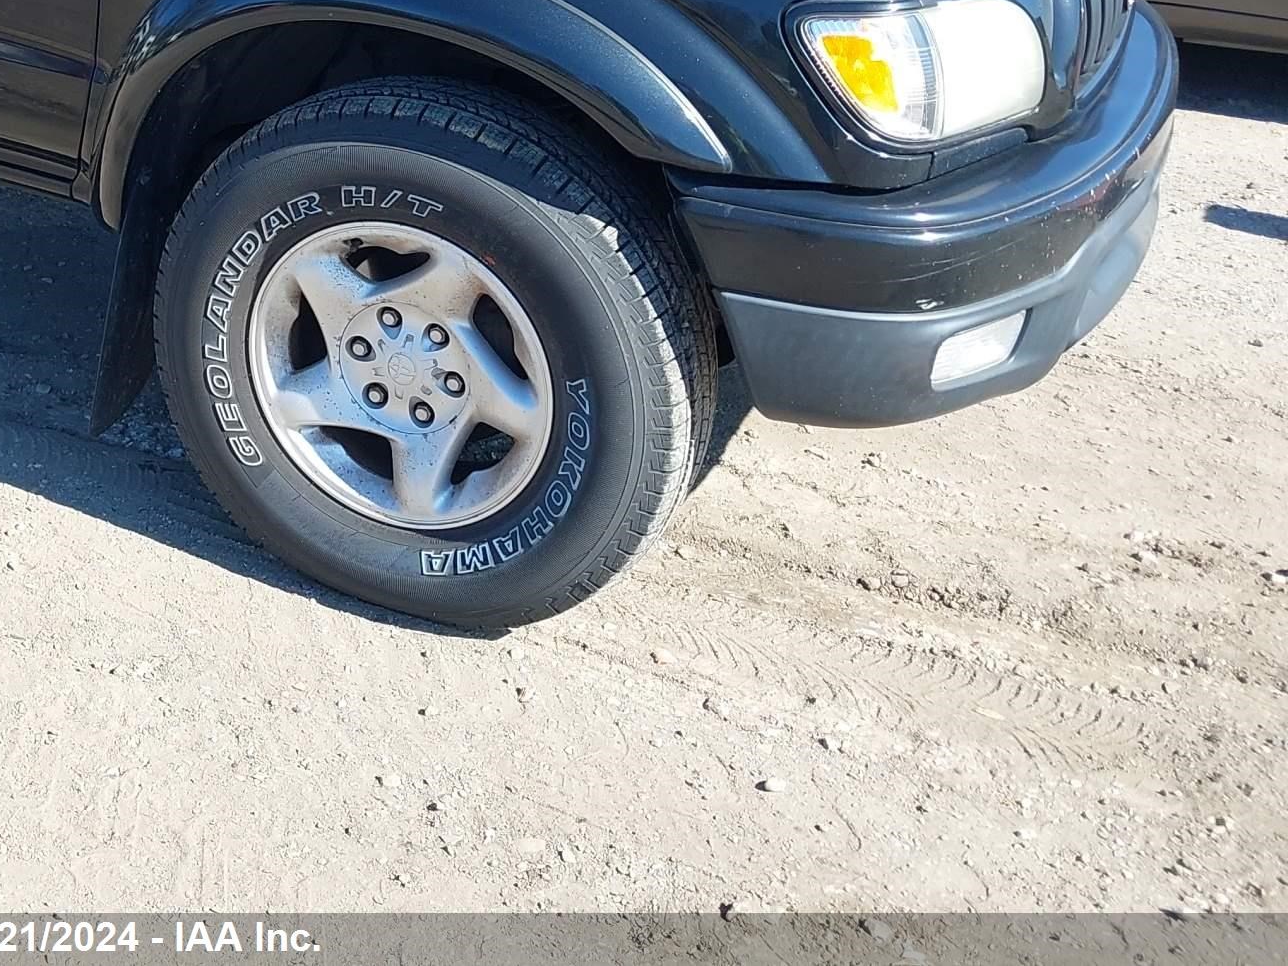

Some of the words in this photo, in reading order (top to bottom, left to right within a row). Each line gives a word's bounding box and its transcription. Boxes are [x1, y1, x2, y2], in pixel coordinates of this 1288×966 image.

[205, 191, 323, 467] GEOLANDAR
[341, 185, 444, 218] H/T
[420, 377, 591, 576] YOKOHAMA
